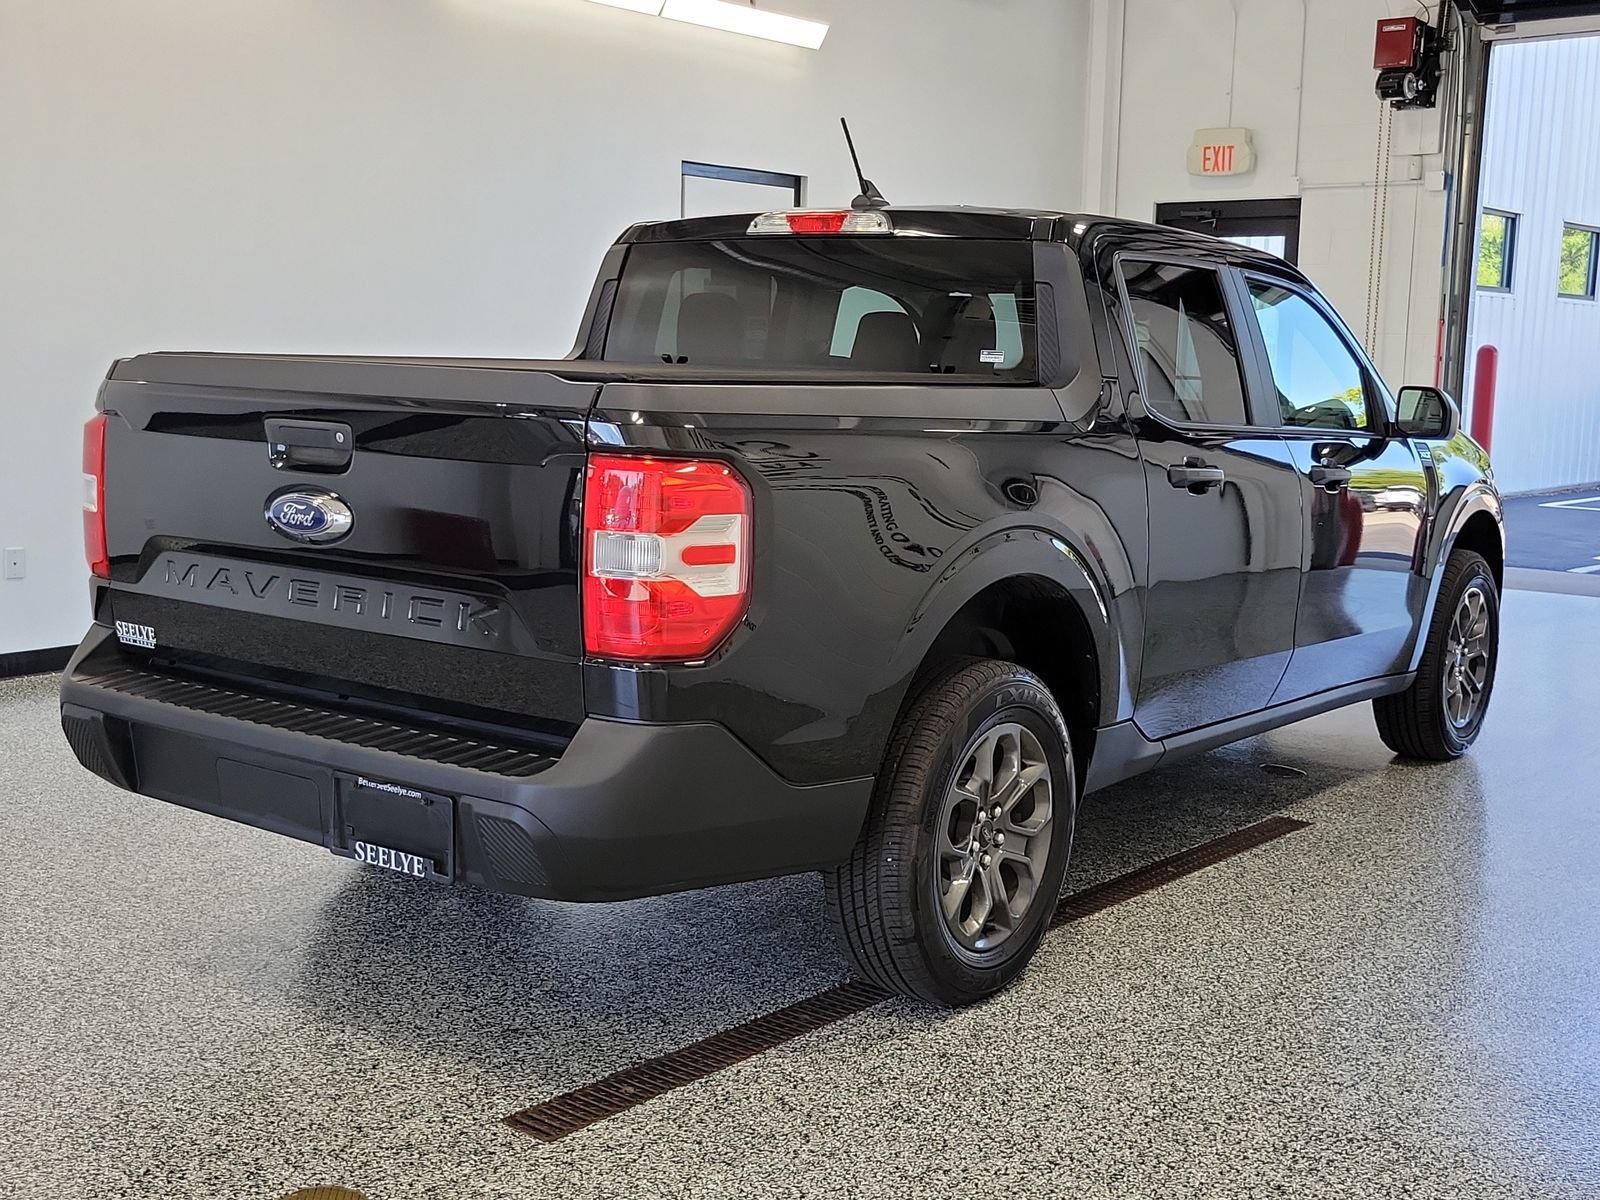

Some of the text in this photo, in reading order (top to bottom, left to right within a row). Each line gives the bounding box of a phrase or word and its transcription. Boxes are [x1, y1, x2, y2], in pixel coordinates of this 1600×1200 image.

[1202, 145, 1235, 172] EXIT
[280, 502, 316, 527] Ford
[164, 560, 499, 637] MAVERICK
[115, 621, 157, 641] SEELYE
[354, 841, 426, 878] SEELYE
